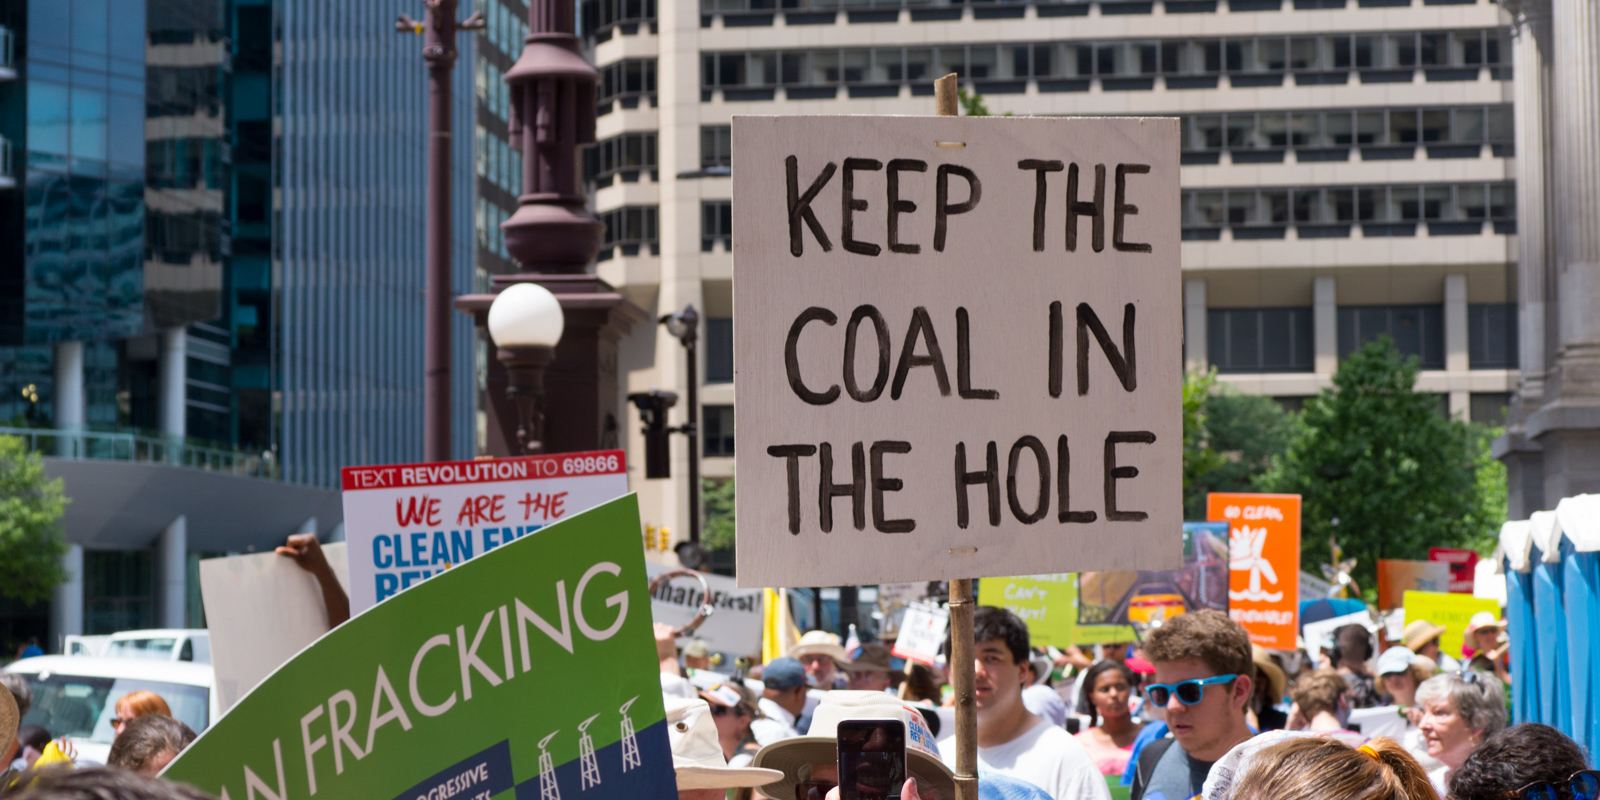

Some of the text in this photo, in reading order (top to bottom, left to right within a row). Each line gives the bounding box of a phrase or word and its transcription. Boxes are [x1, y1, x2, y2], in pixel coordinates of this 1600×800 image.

[784, 154, 1153, 257] KEEP THE
[784, 301, 1137, 405] COAL IN
[350, 455, 619, 487] TEXT REVOLUTION TO 69866
[767, 431, 1157, 535] THE HOLE
[396, 490, 569, 528] WE ARE THE
[1224, 506, 1241, 519] GO
[372, 529, 473, 569] CLEAN
[300, 561, 630, 797] FRACKING
